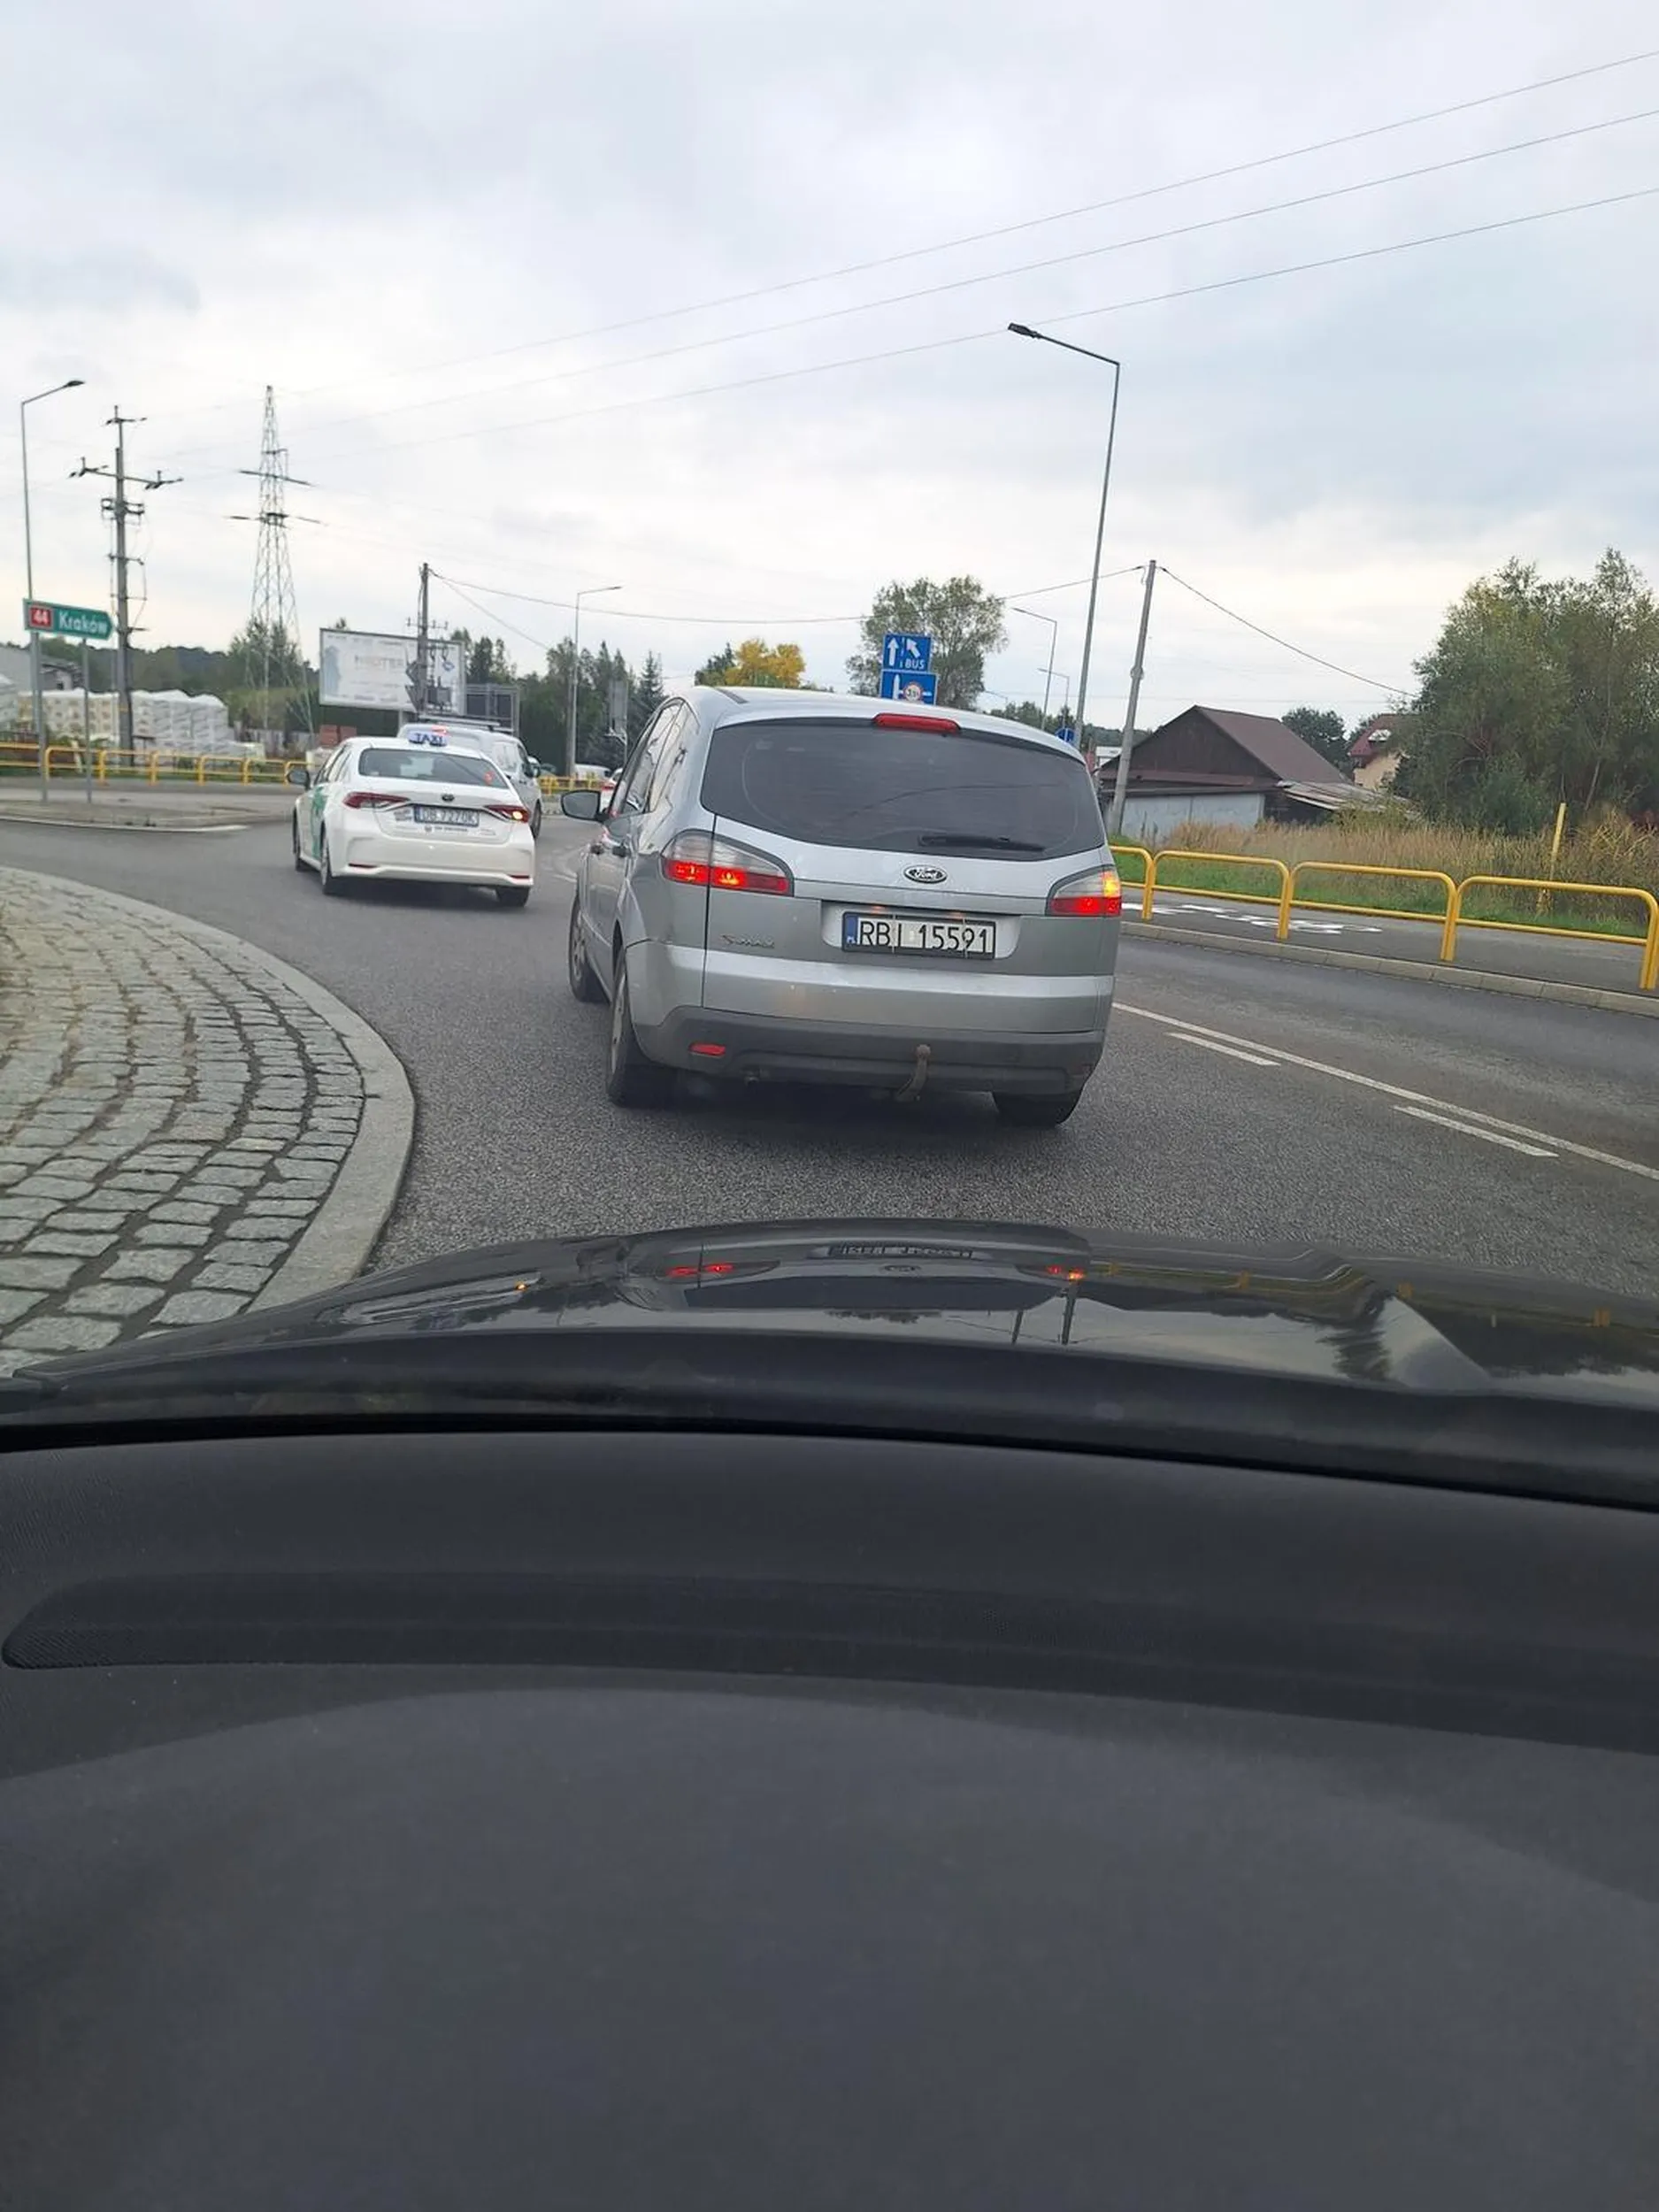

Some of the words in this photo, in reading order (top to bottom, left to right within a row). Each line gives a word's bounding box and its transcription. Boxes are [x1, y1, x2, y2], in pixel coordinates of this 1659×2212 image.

[34, 609, 49, 625] 44
[58, 611, 107, 634] Kraków
[905, 657, 926, 670] BUS
[414, 732, 443, 744] TAXI
[860, 921, 902, 948] RBI
[918, 925, 987, 953] 15591
